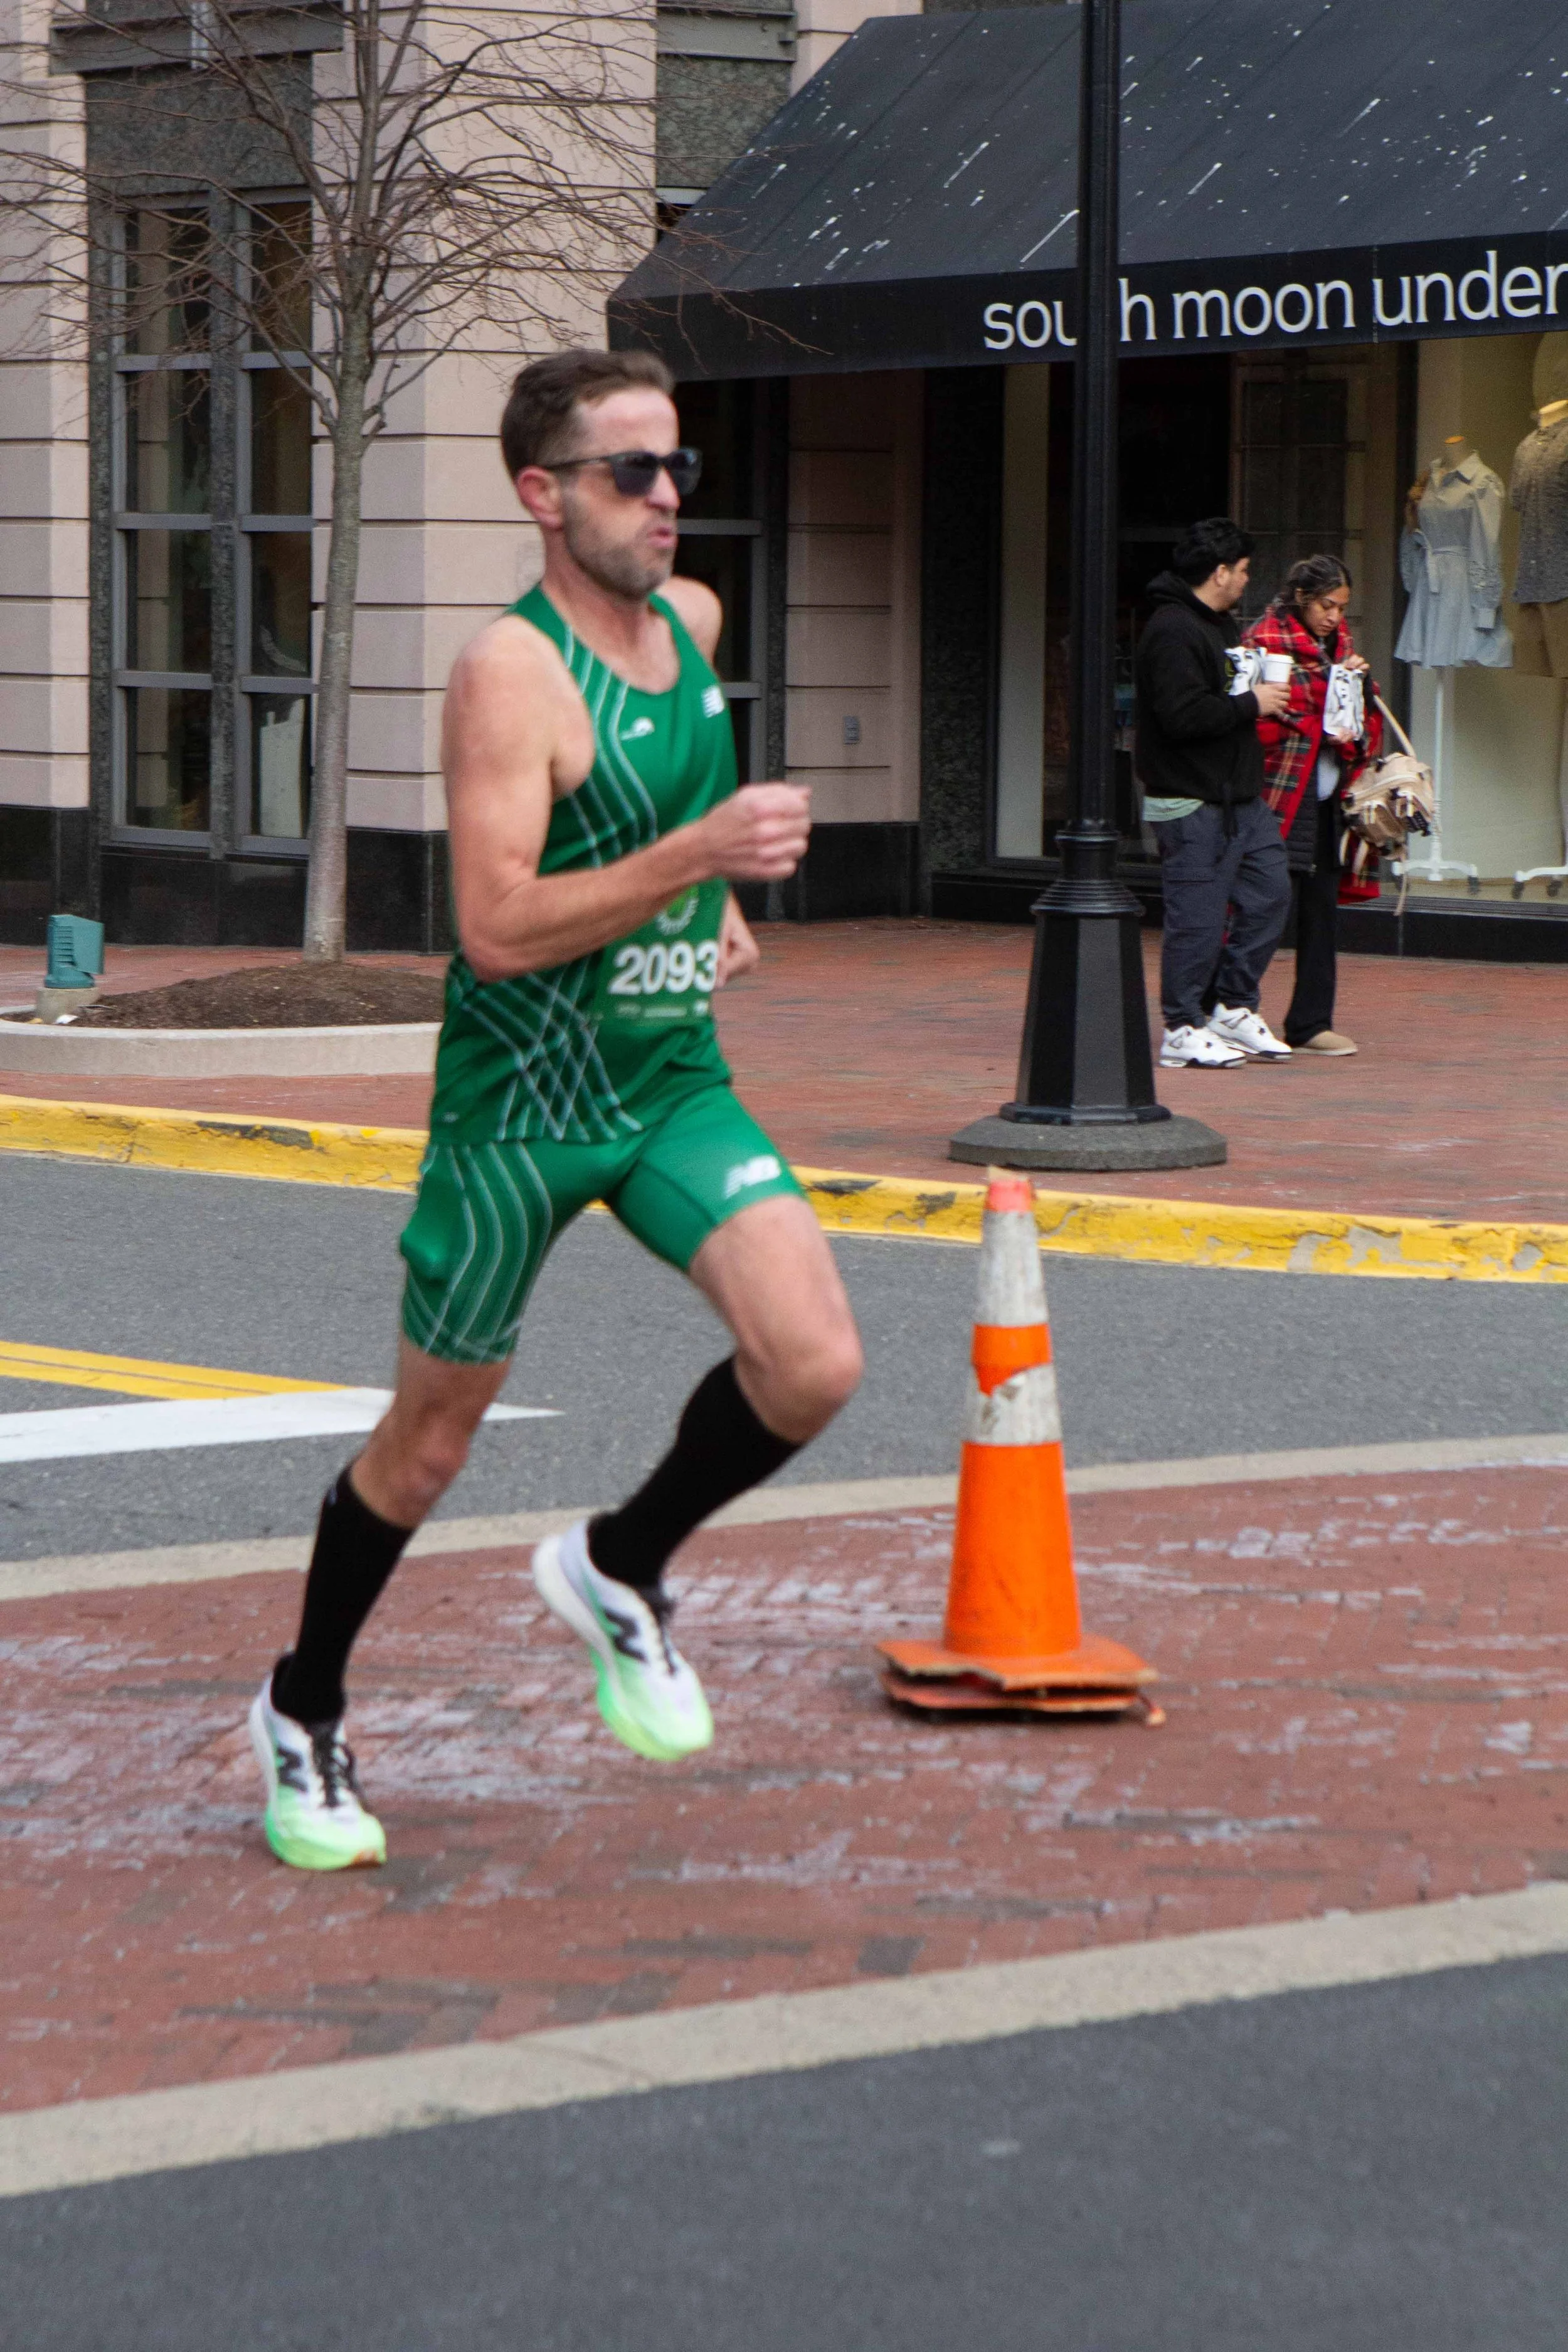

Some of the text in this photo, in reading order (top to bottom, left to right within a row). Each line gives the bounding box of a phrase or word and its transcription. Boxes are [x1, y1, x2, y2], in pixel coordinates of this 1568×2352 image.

[983, 250, 1568, 350] souh moon under
[608, 940, 719, 995] 2093
